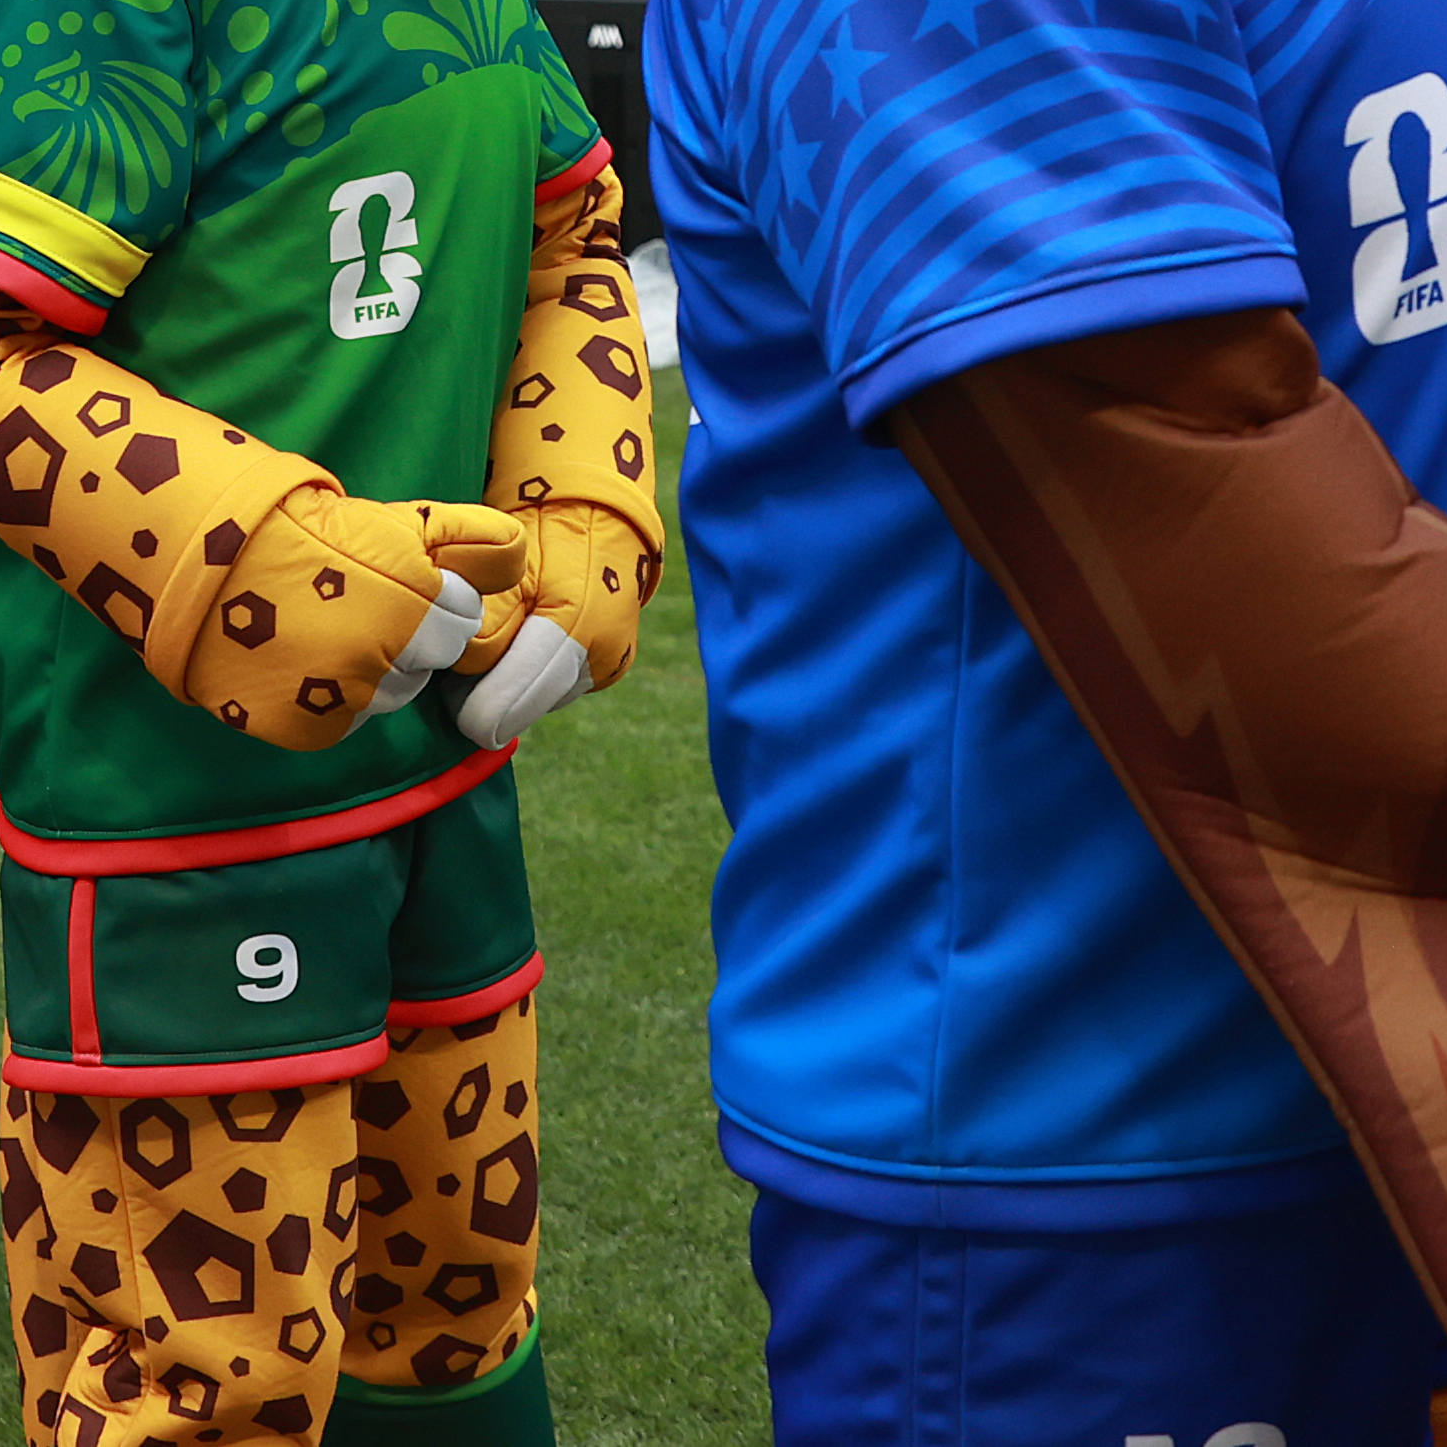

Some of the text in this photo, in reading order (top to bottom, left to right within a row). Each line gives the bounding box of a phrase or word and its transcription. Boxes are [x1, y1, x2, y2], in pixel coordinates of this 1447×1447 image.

[354, 301, 400, 323] FIFA
[1393, 280, 1444, 320] FIFA
[236, 934, 299, 1002] 9
